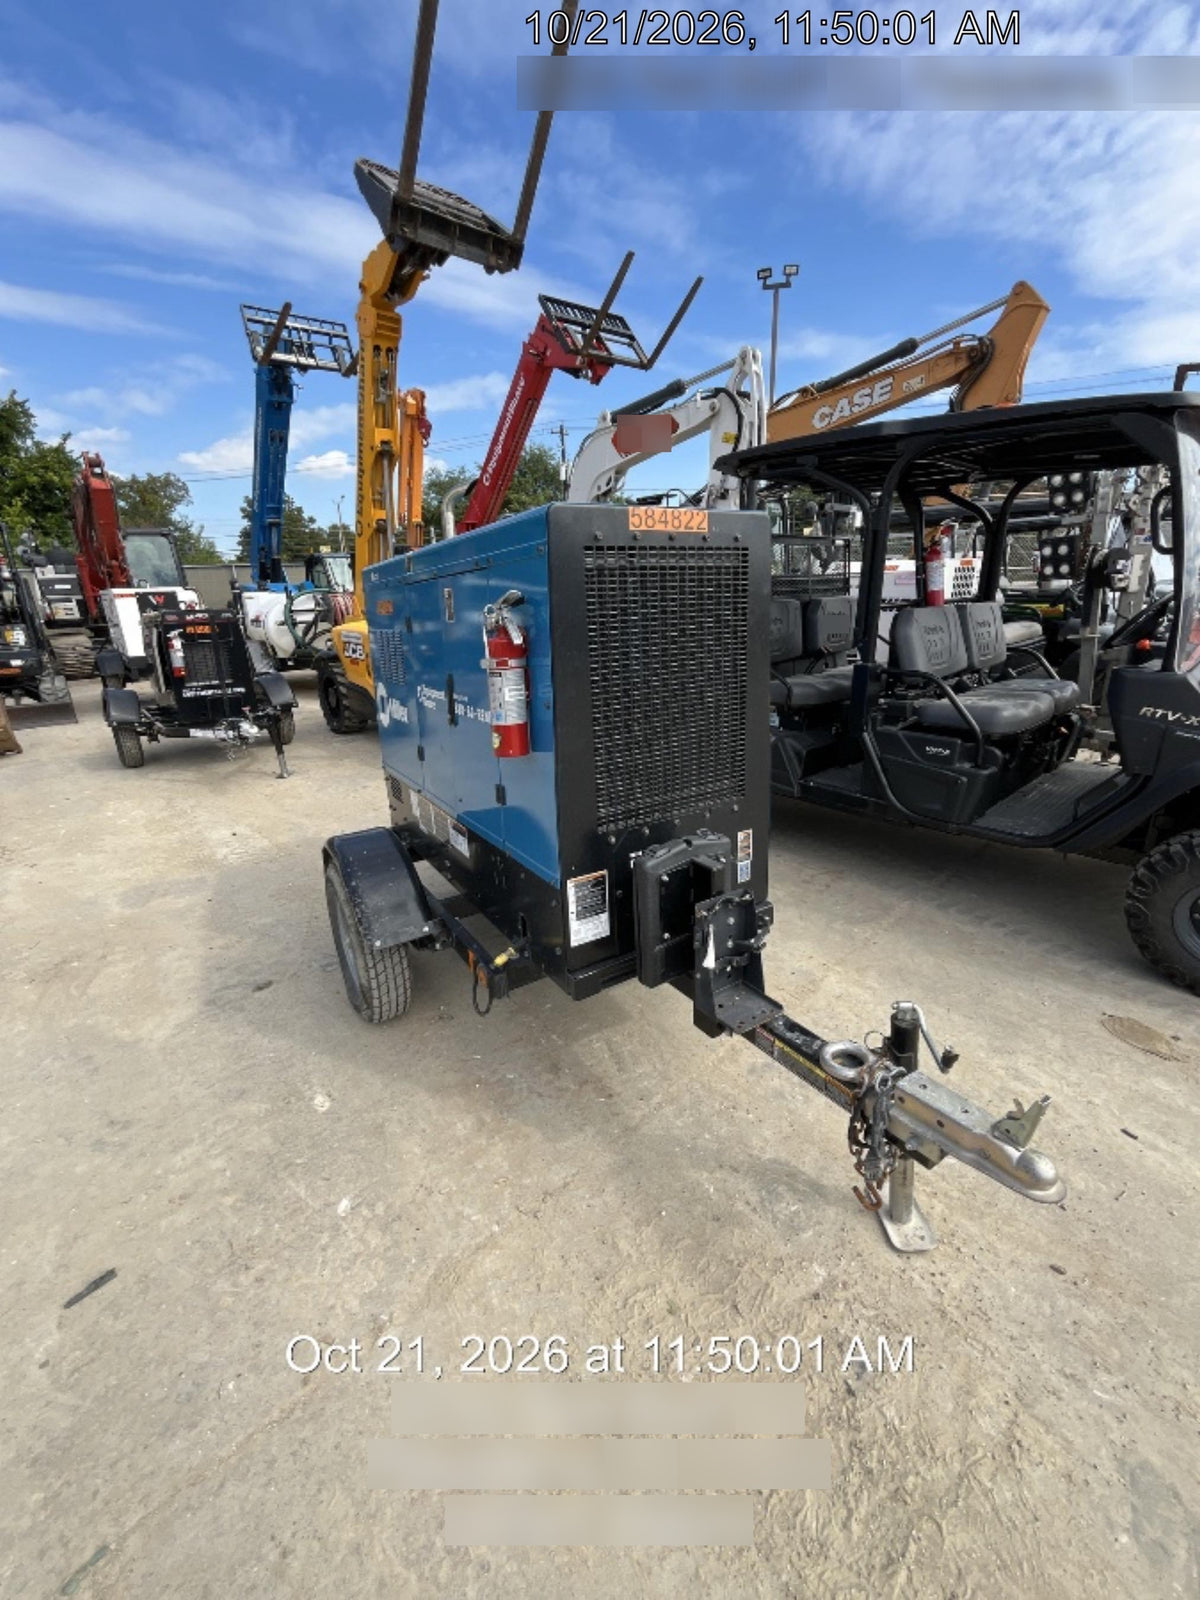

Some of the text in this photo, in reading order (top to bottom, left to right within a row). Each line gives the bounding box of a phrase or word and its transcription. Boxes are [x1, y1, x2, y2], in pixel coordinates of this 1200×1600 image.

[812, 375, 894, 429] CASE
[630, 508, 707, 530] 584822
[344, 643, 365, 659] JCB
